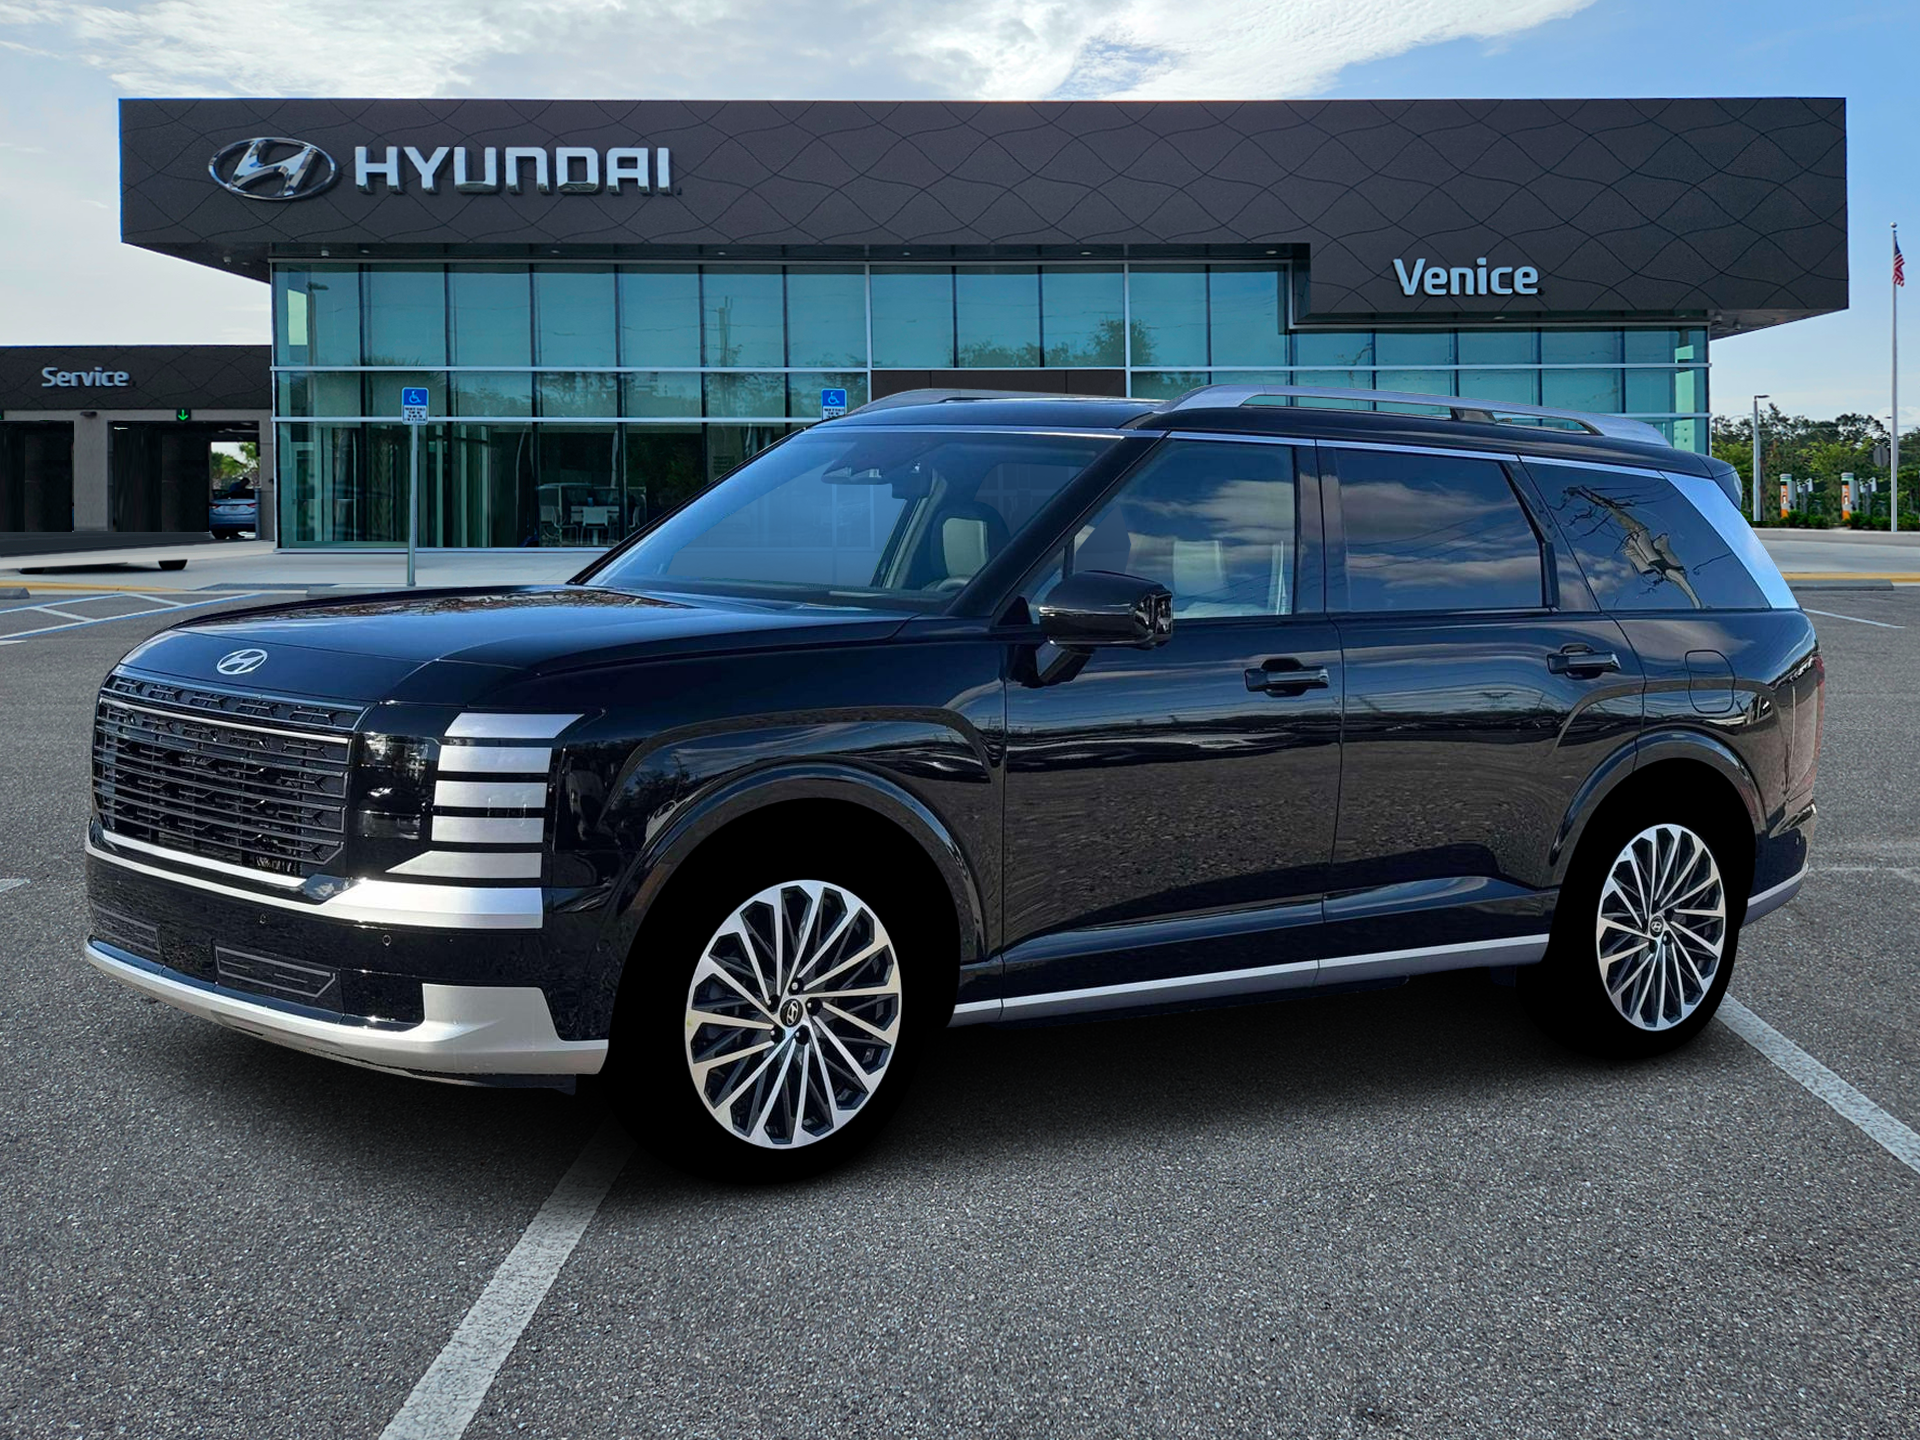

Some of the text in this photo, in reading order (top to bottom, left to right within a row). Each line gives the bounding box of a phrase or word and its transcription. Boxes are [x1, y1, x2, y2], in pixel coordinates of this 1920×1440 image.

[354, 146, 672, 194] HYUNDAI
[1393, 257, 1539, 296] Venice
[41, 366, 130, 387] Service
